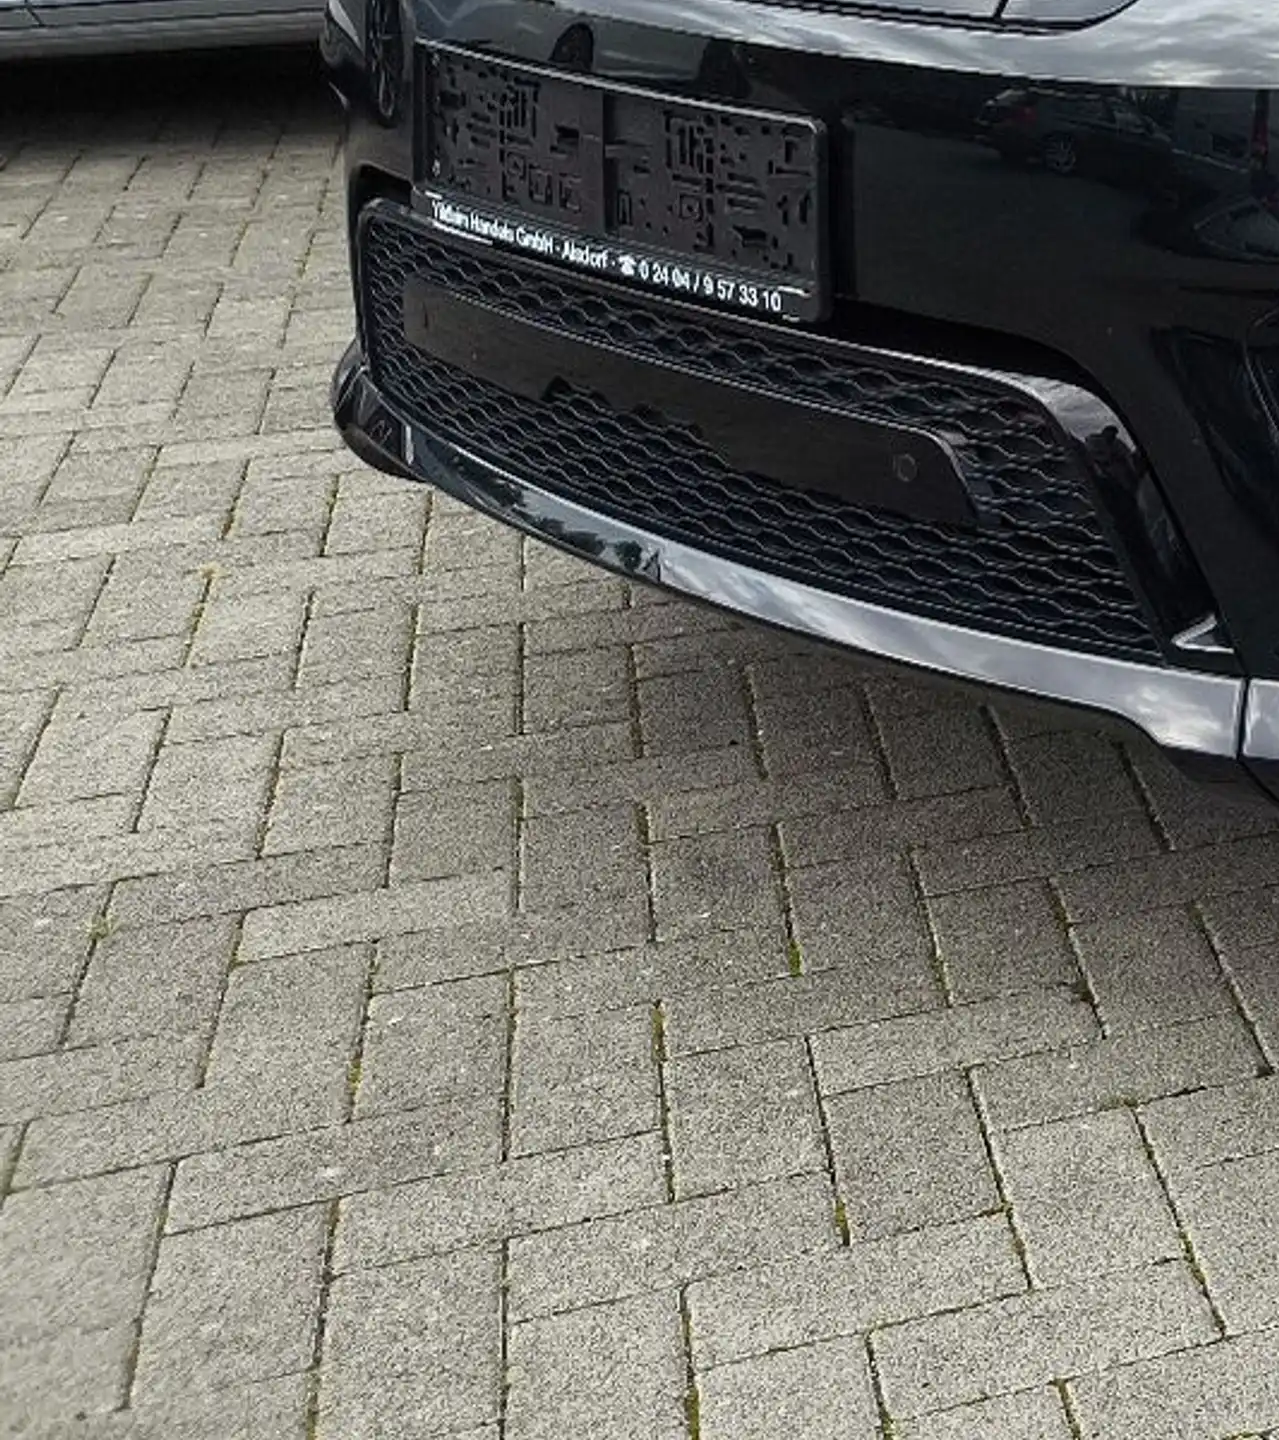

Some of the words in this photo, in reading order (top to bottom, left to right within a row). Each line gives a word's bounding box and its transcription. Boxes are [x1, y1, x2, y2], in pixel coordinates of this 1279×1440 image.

[652, 262, 670, 286] 24
[671, 267, 691, 291] 04
[717, 280, 736, 301] 57
[738, 285, 759, 308] 33
[761, 291, 782, 312] 10
